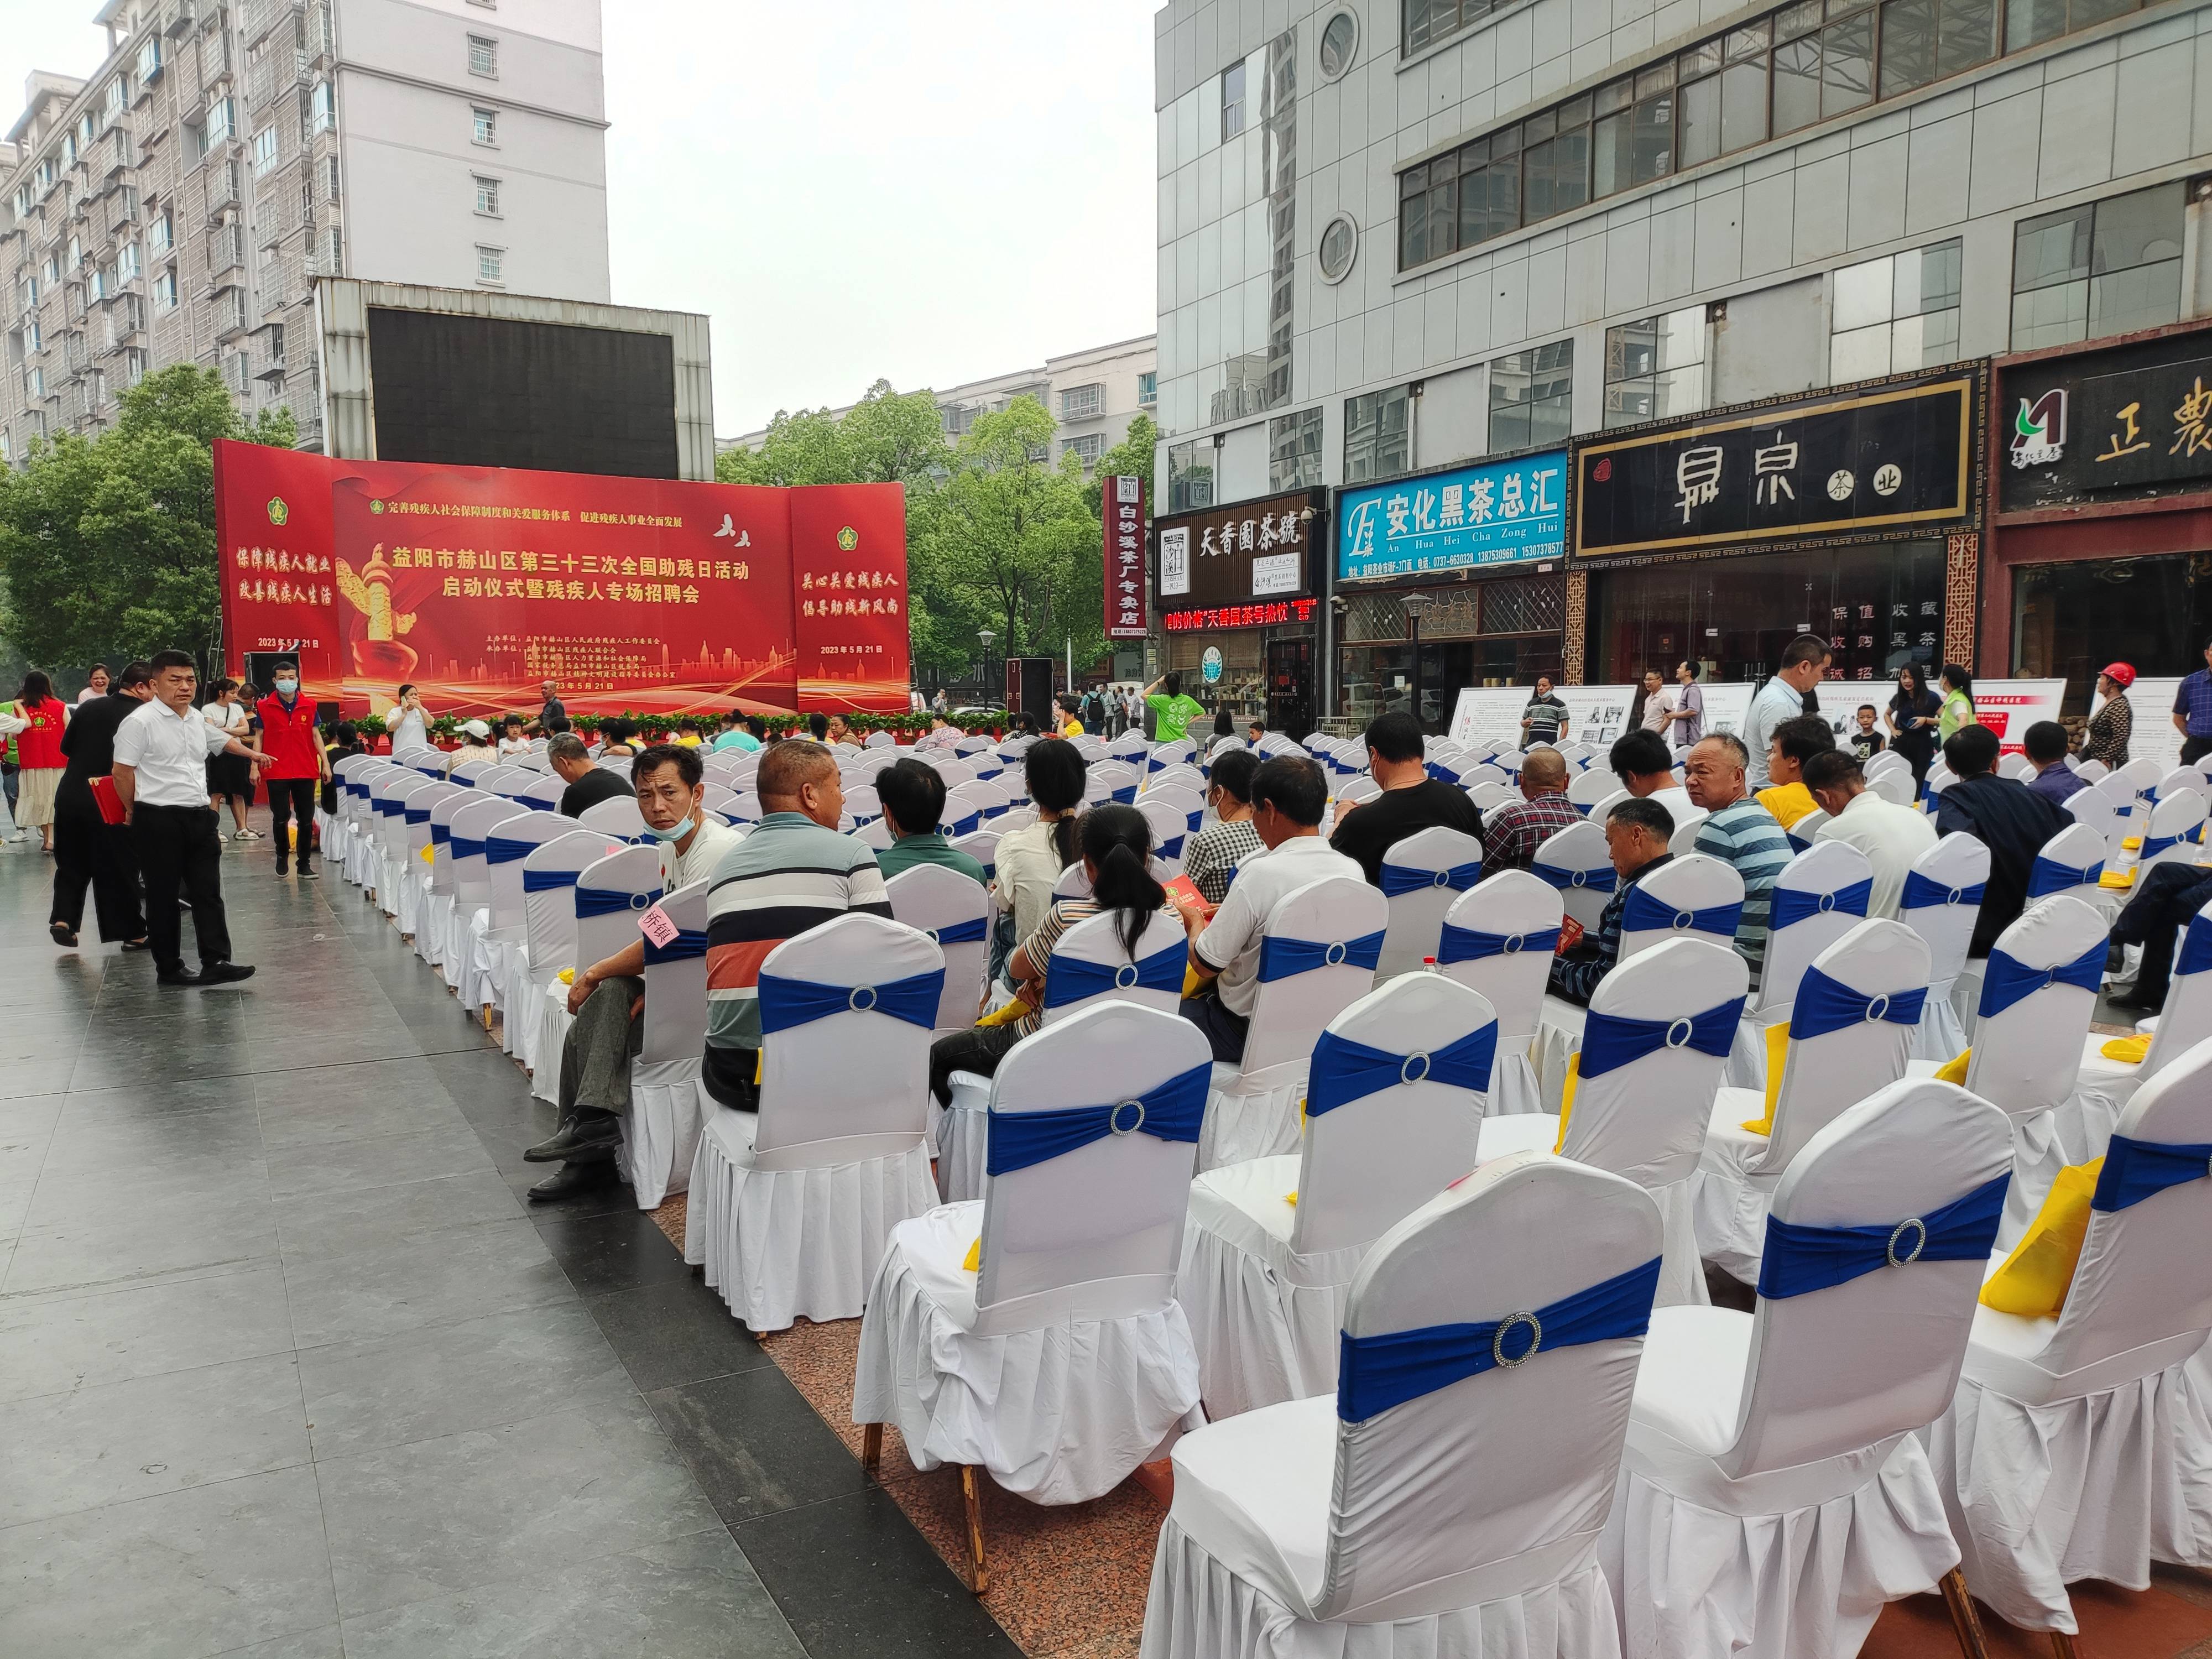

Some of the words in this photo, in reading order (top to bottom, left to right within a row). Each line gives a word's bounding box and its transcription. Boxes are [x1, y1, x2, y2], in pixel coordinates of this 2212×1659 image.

[1827, 469, 1897, 498] 茶业
[388, 501, 571, 521] 完善残疾人社会保障制度和关爱服务体系
[580, 512, 683, 528] 促进残疾人事业全面发展
[1386, 468, 1558, 536] 安化黑茶总汇
[1387, 545, 1400, 553] An
[1415, 539, 1434, 549] Hua
[1443, 535, 1460, 546] Hei
[1472, 531, 1491, 542] Cha
[1501, 527, 1527, 539] Zong
[1537, 522, 1558, 534] Hui
[1478, 547, 1517, 562] 13875309661
[1521, 541, 1563, 557] 15307378577
[236, 546, 331, 575] 保障残疾人就业
[392, 546, 749, 581] 益阳市赫山区第三十三次全国助残日活动
[1118, 505, 1140, 625] 白沙溪茶厂专卖店
[239, 578, 332, 606] 改善残疾人生活
[442, 576, 700, 604] 启动仪式暨残疾人专场招聘会
[802, 571, 899, 590] 关心关爱残疾人
[802, 597, 899, 617] 倡导助残新风尚
[555, 682, 614, 690] 23年5月21日
